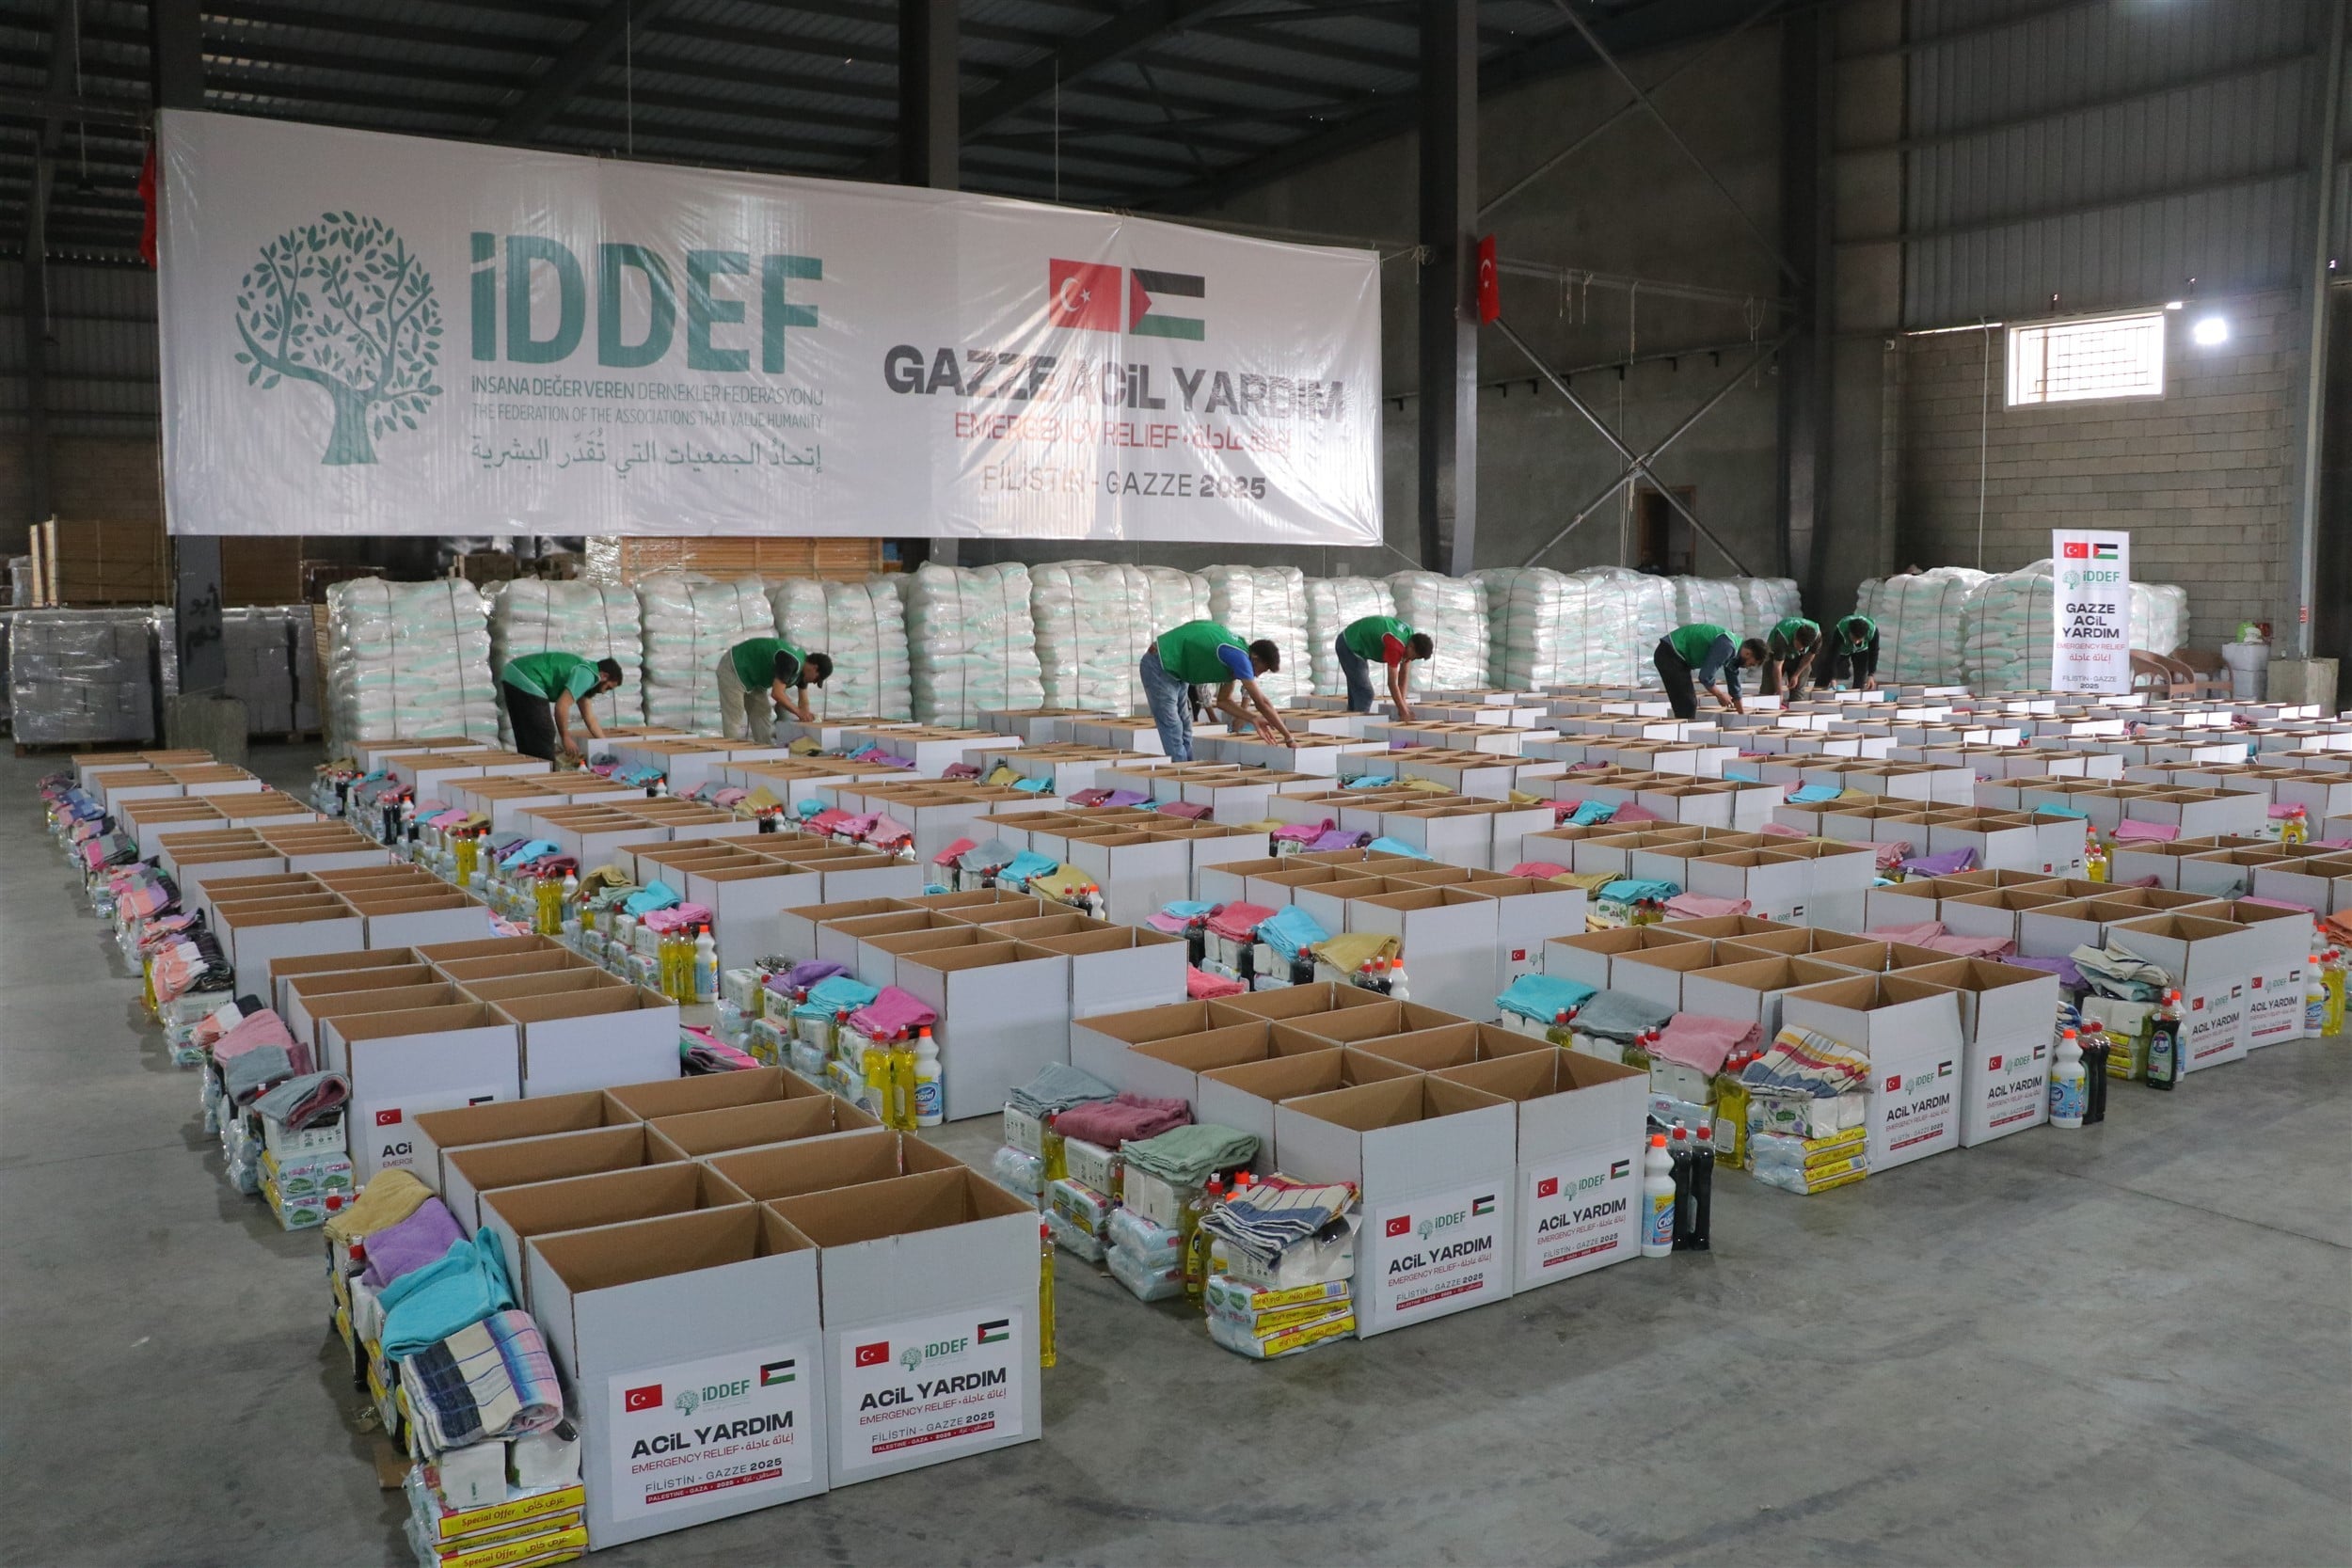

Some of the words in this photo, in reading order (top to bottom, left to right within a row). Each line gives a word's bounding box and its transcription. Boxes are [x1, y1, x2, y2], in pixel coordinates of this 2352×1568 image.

[532, 373, 581, 397] DEĞER
[584, 380, 634, 400] VEREN
[638, 382, 721, 403] DERNEKLER
[723, 386, 823, 406] FEDERASYONU
[883, 344, 1056, 401] GAZZE
[1172, 367, 1344, 422] YARDIM
[471, 403, 495, 420] THE
[498, 404, 569, 421] FEDERATION
[572, 406, 588, 421] OF
[590, 407, 612, 423] THE
[615, 407, 695, 426] ASSOCIATIONS
[699, 411, 726, 426] THAT
[730, 412, 766, 428] VALUE
[768, 413, 823, 429] HUMANITY
[955, 412, 1099, 445] EMERGENCY
[1104, 420, 1178, 450] RELIEF
[471, 435, 549, 468] البشرية
[615, 439, 656, 479] التي
[664, 440, 761, 473] الجمعيات
[1106, 470, 1193, 498] GAZZE
[1200, 474, 1266, 499] 2025
[2066, 603, 2116, 614] GAZZE
[2062, 627, 2120, 640] YARDIM
[2010, 1075, 2042, 1093] YARDIM
[1912, 1092, 1950, 1114] YARDIM
[382, 1141, 412, 1158] ACi
[382, 1157, 413, 1168] EMERGE
[1573, 1197, 1627, 1224] YARDIM
[1537, 1227, 1576, 1245] EMERGENCY
[1576, 1222, 1597, 1235] RELIEF
[1600, 1233, 1618, 1243] 2025
[1429, 1235, 1492, 1263] YARDIM
[1388, 1269, 1433, 1287] EMERGENCY
[1433, 1262, 1456, 1275] RELIEF
[1435, 1280, 1461, 1291] GAZZE
[1462, 1273, 1484, 1284] 2025
[917, 1367, 1007, 1399] YARDIM
[860, 1405, 923, 1425] EMERGENCY
[925, 1398, 957, 1412] RELIEF
[927, 1418, 963, 1433] GAZZE
[966, 1411, 994, 1424] 2025
[694, 1411, 793, 1445] YARDIM
[874, 1441, 907, 1452] PALESTINE
[911, 1436, 929, 1445] GAZA
[631, 1452, 701, 1474] EMERGENCY
[704, 1445, 739, 1460] RELIEF
[706, 1465, 747, 1481] GAZZE
[750, 1458, 782, 1471] 2025
[648, 1490, 685, 1503] PALESTINE
[690, 1485, 708, 1494] GAZA
[716, 1480, 734, 1488] 2025
[462, 1511, 492, 1527] Special
[493, 1508, 516, 1520] Offer
[463, 1553, 494, 1567] Special
[496, 1549, 517, 1560] Offer
